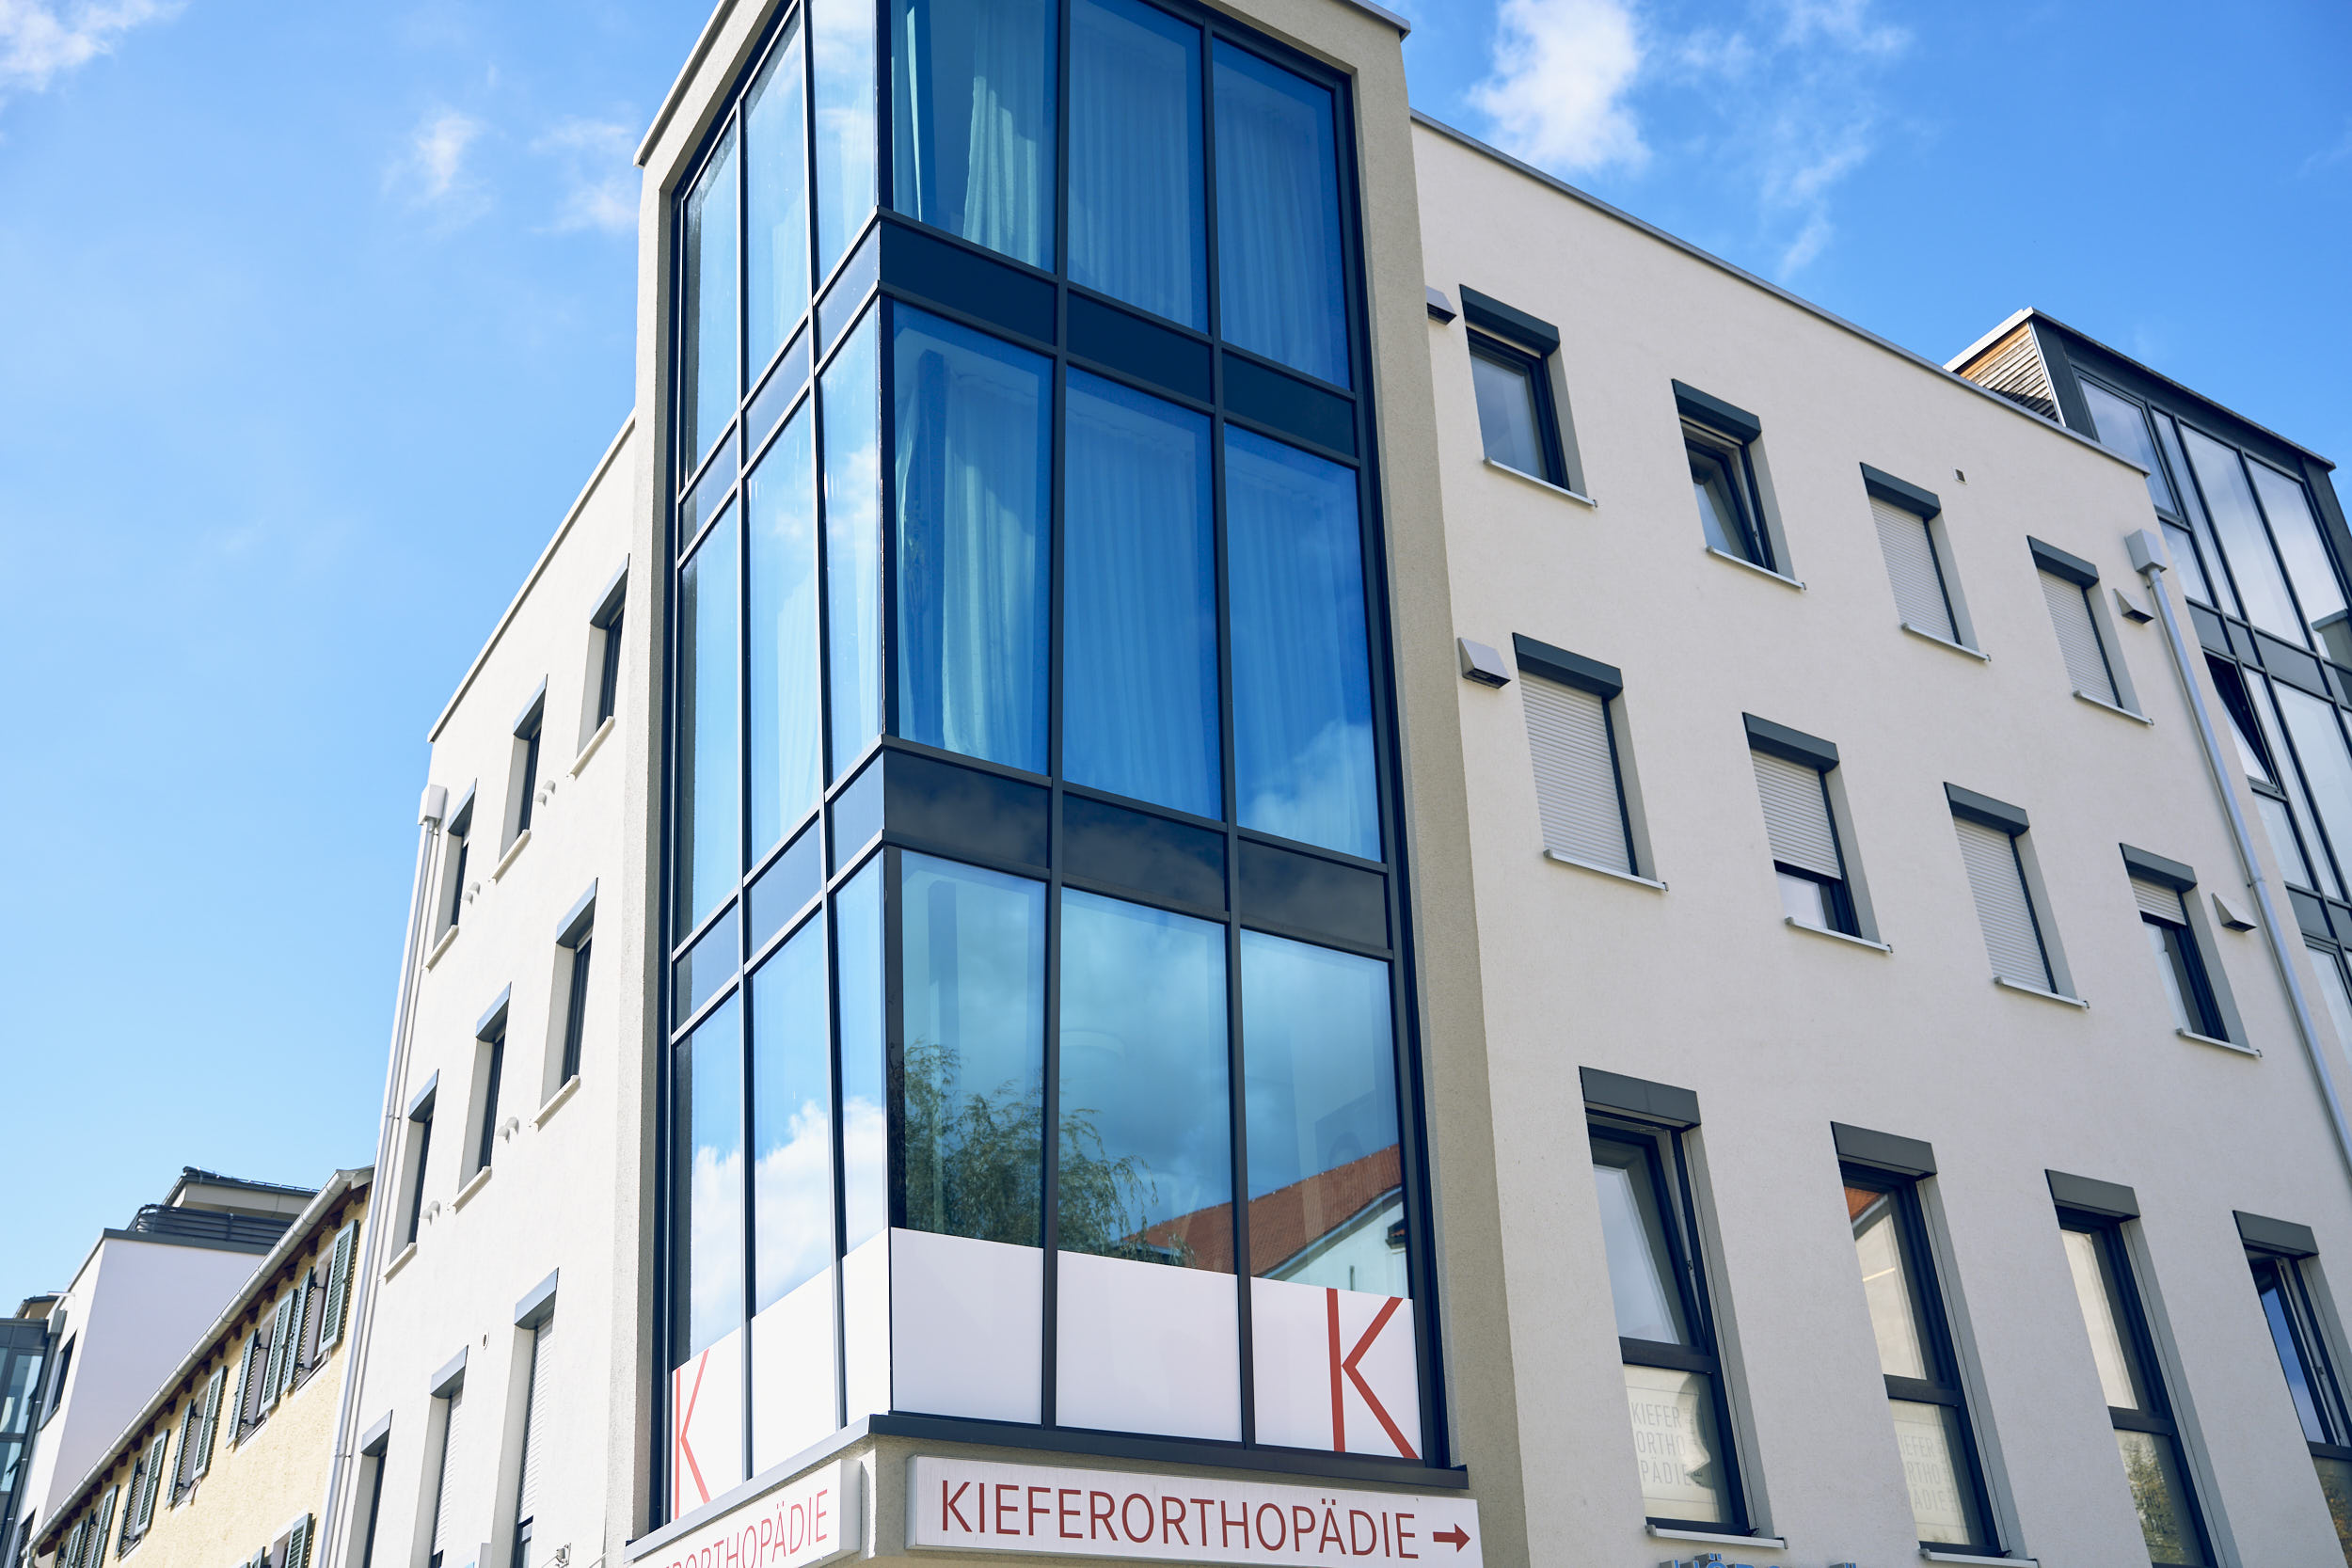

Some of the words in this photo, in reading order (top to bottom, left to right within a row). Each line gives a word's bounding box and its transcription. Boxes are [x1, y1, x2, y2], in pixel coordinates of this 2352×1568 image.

[1327, 1287, 1420, 1460] K
[675, 1348, 711, 1521] K
[1630, 1402, 1682, 1429] KIEFER
[1635, 1430, 1687, 1456] ORTHO
[1640, 1456, 1692, 1486] PÄDIE
[941, 1479, 1419, 1560] KIEFERORTHOPÄDIE
